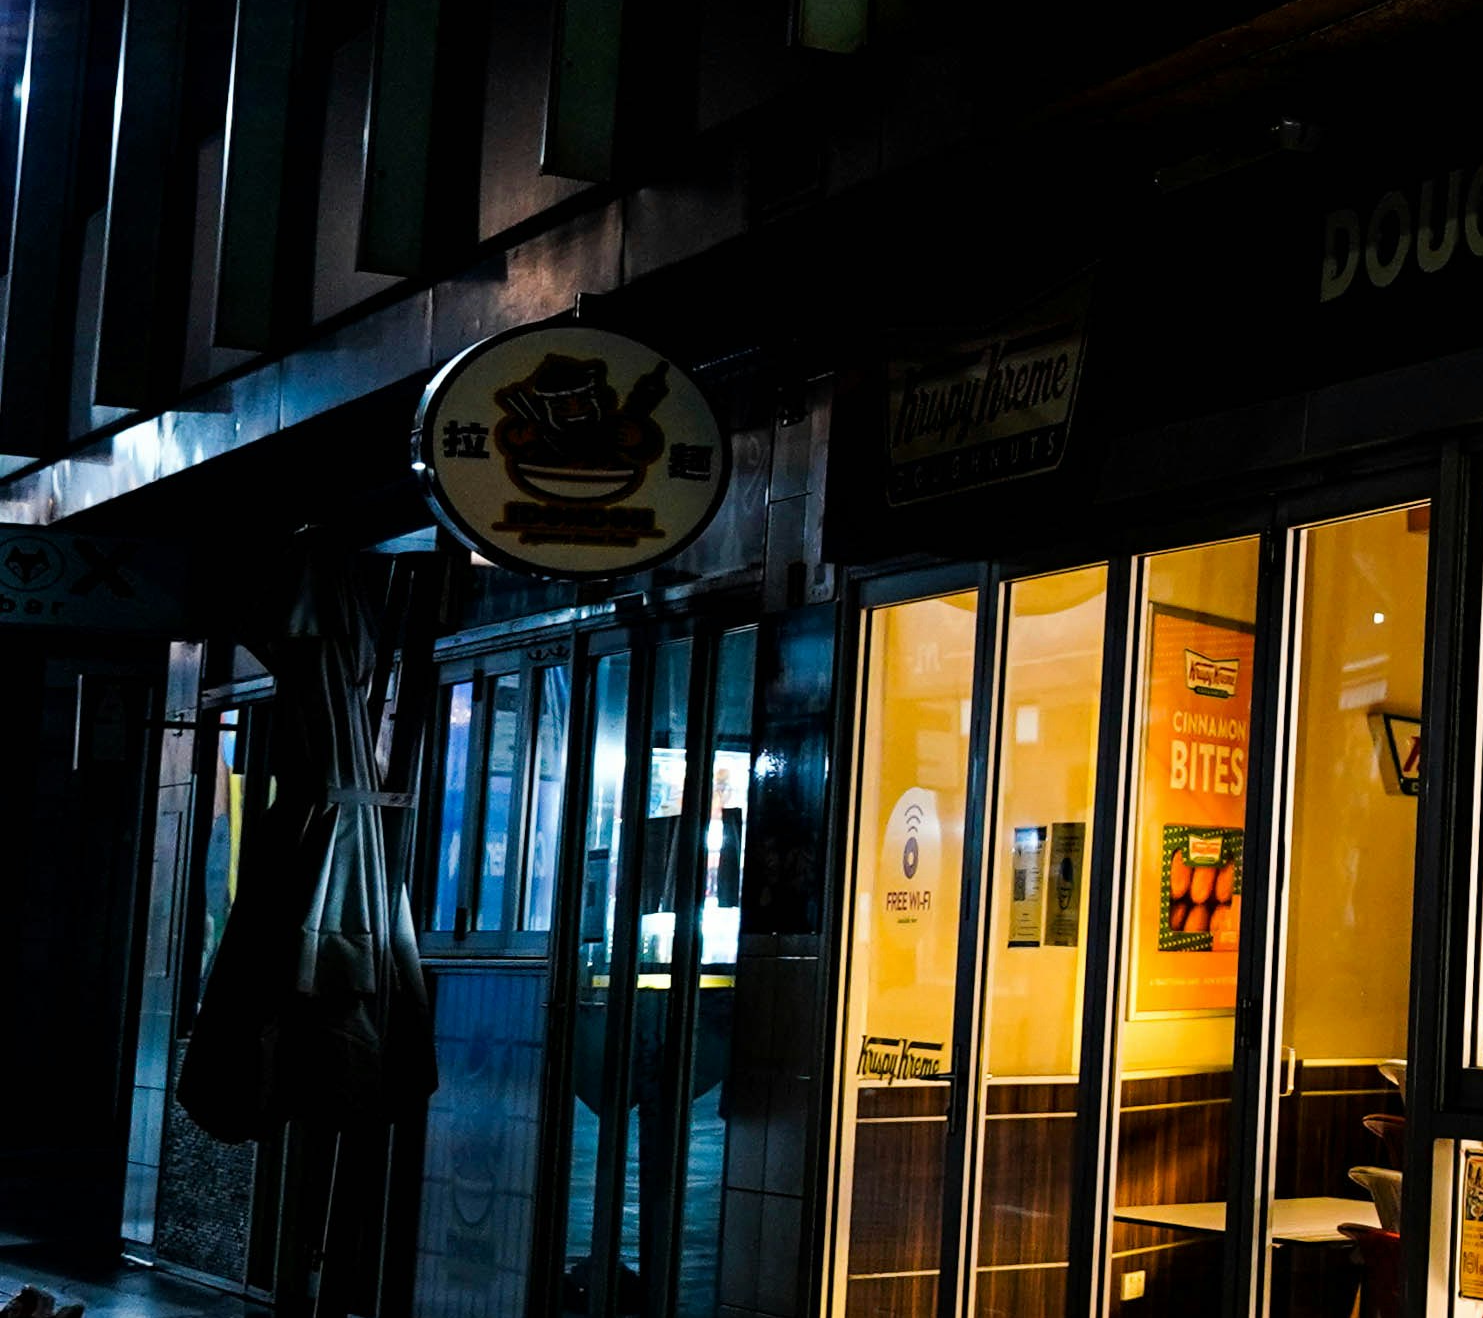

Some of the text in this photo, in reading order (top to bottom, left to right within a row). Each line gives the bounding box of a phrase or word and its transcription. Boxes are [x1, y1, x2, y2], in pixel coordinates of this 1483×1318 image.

[1172, 709, 1248, 742] CINNAMON
[1169, 739, 1245, 797] BITES
[886, 890, 931, 911] FREE WI-FI
[856, 1035, 945, 1086] Krispy Kreme
